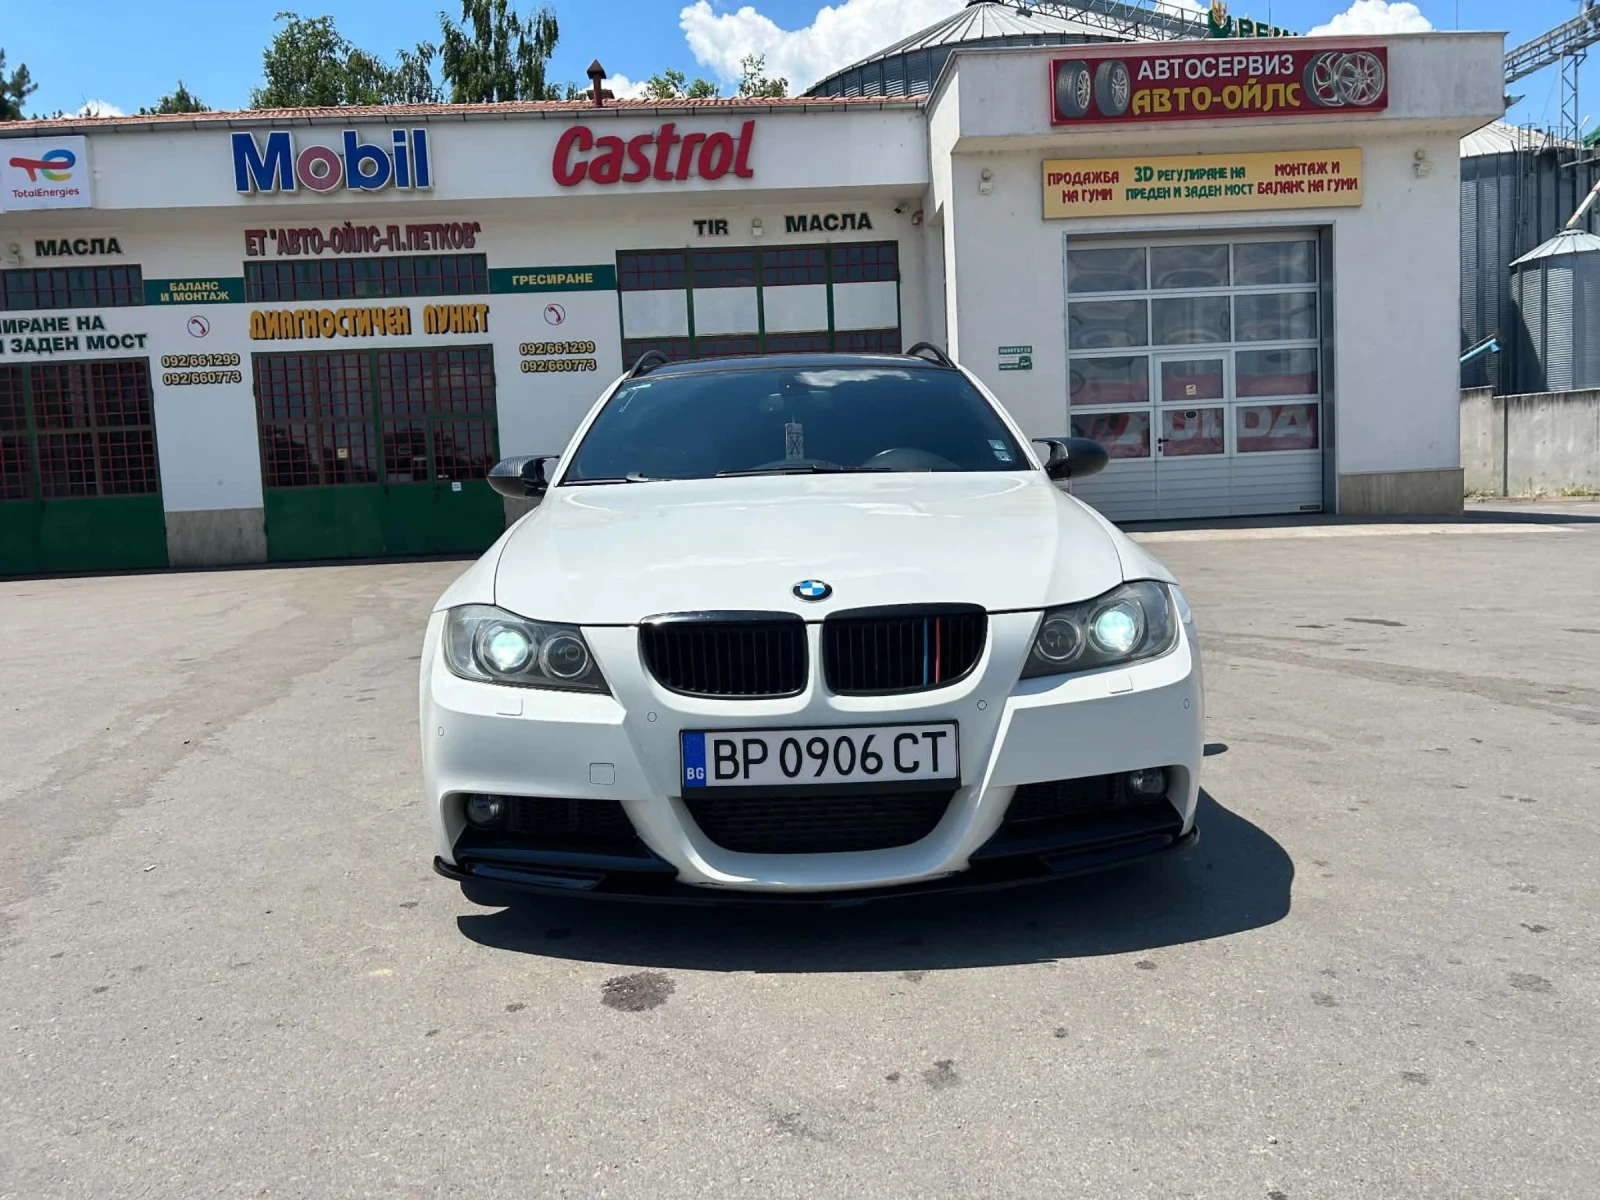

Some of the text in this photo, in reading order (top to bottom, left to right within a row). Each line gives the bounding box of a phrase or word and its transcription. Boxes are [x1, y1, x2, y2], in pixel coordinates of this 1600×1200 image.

[1137, 54, 1294, 80] АВТОСЕРВИЗ
[1132, 78, 1301, 115] АВТО-ОЙЛС
[231, 128, 431, 193] Mobil
[552, 120, 755, 187] Castrol
[1134, 166, 1246, 182] 3D РЕГУЛИРАНЕ НА
[1274, 161, 1340, 176] МОНТАЖ И
[1047, 171, 1119, 186] ПРОДАЖБА
[1257, 178, 1358, 195] БАЛАНС НА ГУМИ
[12, 187, 80, 198] TotalEnergies
[1062, 188, 1113, 204] НА ГУМИ
[1126, 184, 1254, 201] ПРЕДЕН И ЗАДЕН МОСТ
[693, 219, 729, 235] TIR
[785, 212, 873, 232] МАСЛА
[35, 238, 122, 257] МАСЛА
[244, 229, 268, 256] ЕТ
[169, 282, 219, 291] БАЛАНС
[512, 273, 594, 285] ГРЕСИРАНЕ
[161, 291, 229, 302] И МОНТАЖ
[0, 316, 105, 334] ИРАНЕ НА
[250, 304, 490, 340] ДИАГНОСТИЧЕН ПУНКТ
[11, 335, 79, 354] ЗАДЕН
[86, 333, 147, 350] МОСТ
[519, 341, 595, 355] 092/661299
[161, 354, 240, 367] 092/661299
[521, 359, 597, 372] 092/660773
[162, 370, 242, 385] 092/660773
[713, 731, 947, 780] BP 0906 CT
[687, 767, 705, 779] BG
